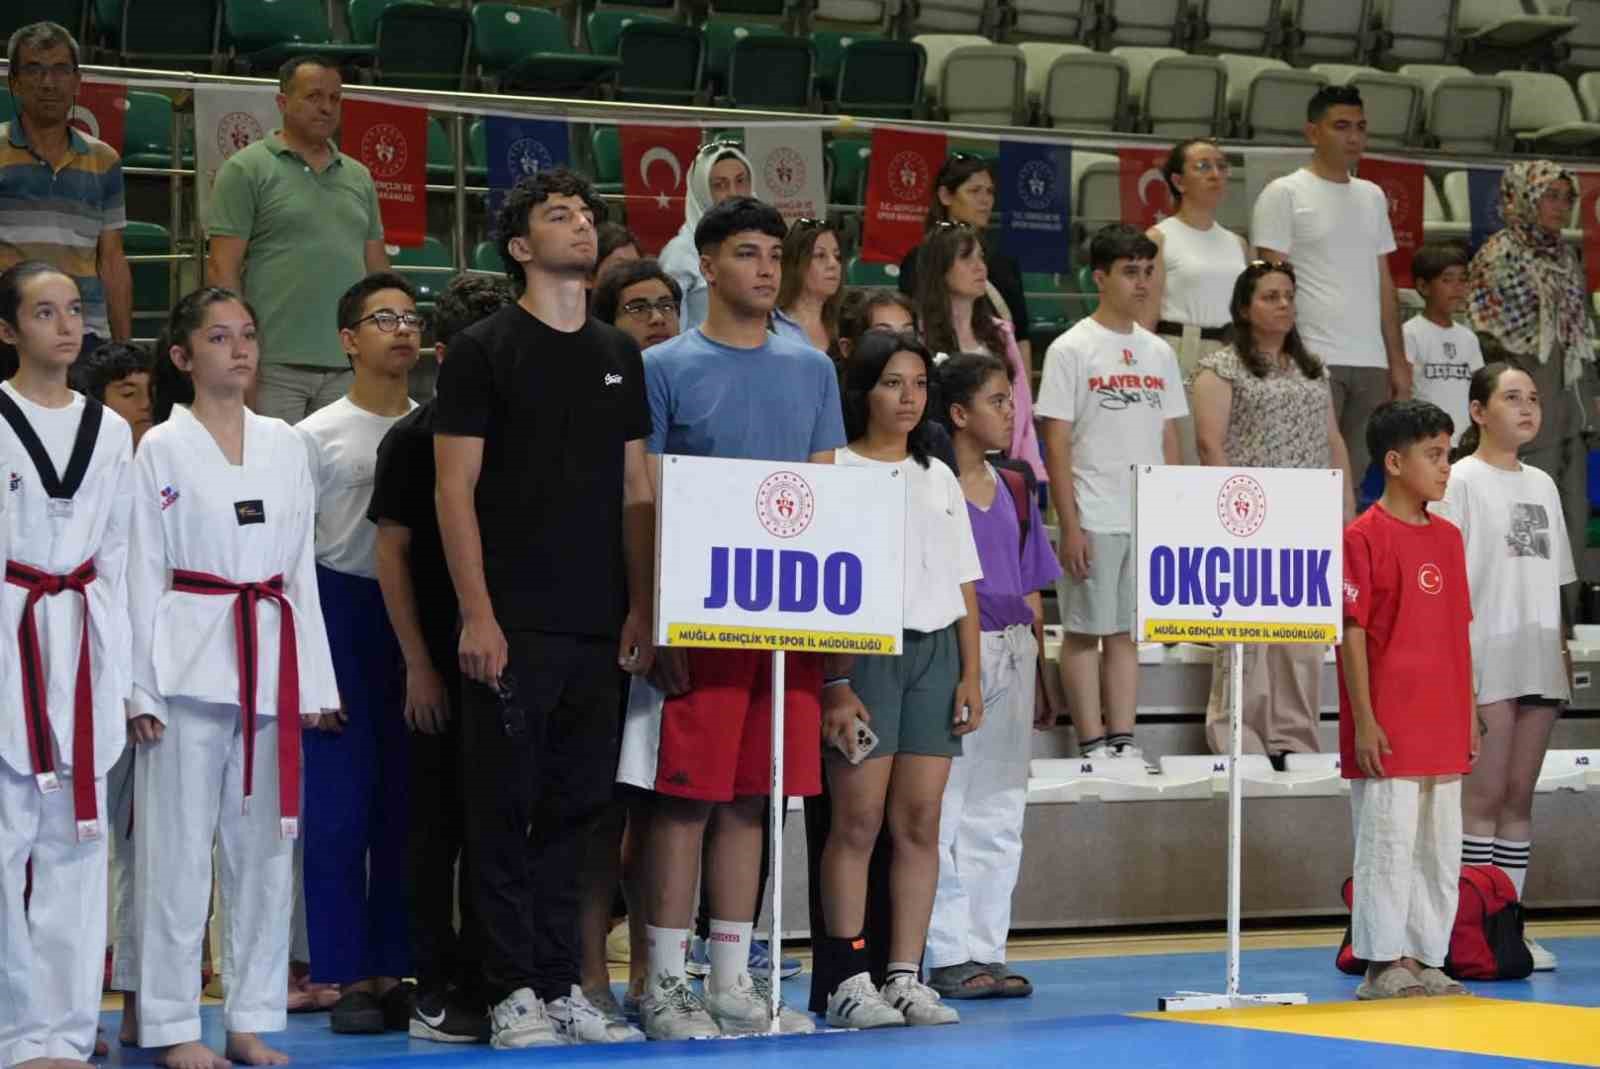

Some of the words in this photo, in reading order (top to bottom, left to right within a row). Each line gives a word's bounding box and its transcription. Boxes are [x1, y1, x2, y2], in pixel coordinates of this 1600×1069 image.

[1088, 374, 1142, 392] PLAYER
[703, 546, 863, 616] JUDO
[1150, 545, 1332, 618] OKÇULUK
[679, 629, 716, 642] MUĞLA
[719, 631, 763, 646] GENÇLİK
[764, 635, 778, 646] VE
[779, 635, 805, 647] SPOR
[807, 635, 816, 649] İL
[819, 635, 882, 651] MÜDÜRLÜĞÜ
[1154, 624, 1187, 636] MUĞLA
[1188, 625, 1225, 638] GENÇLİK
[1226, 628, 1239, 637] VE
[1239, 628, 1262, 638] SPOR
[1272, 627, 1326, 640] MÜDÜRLÜĞÜ
